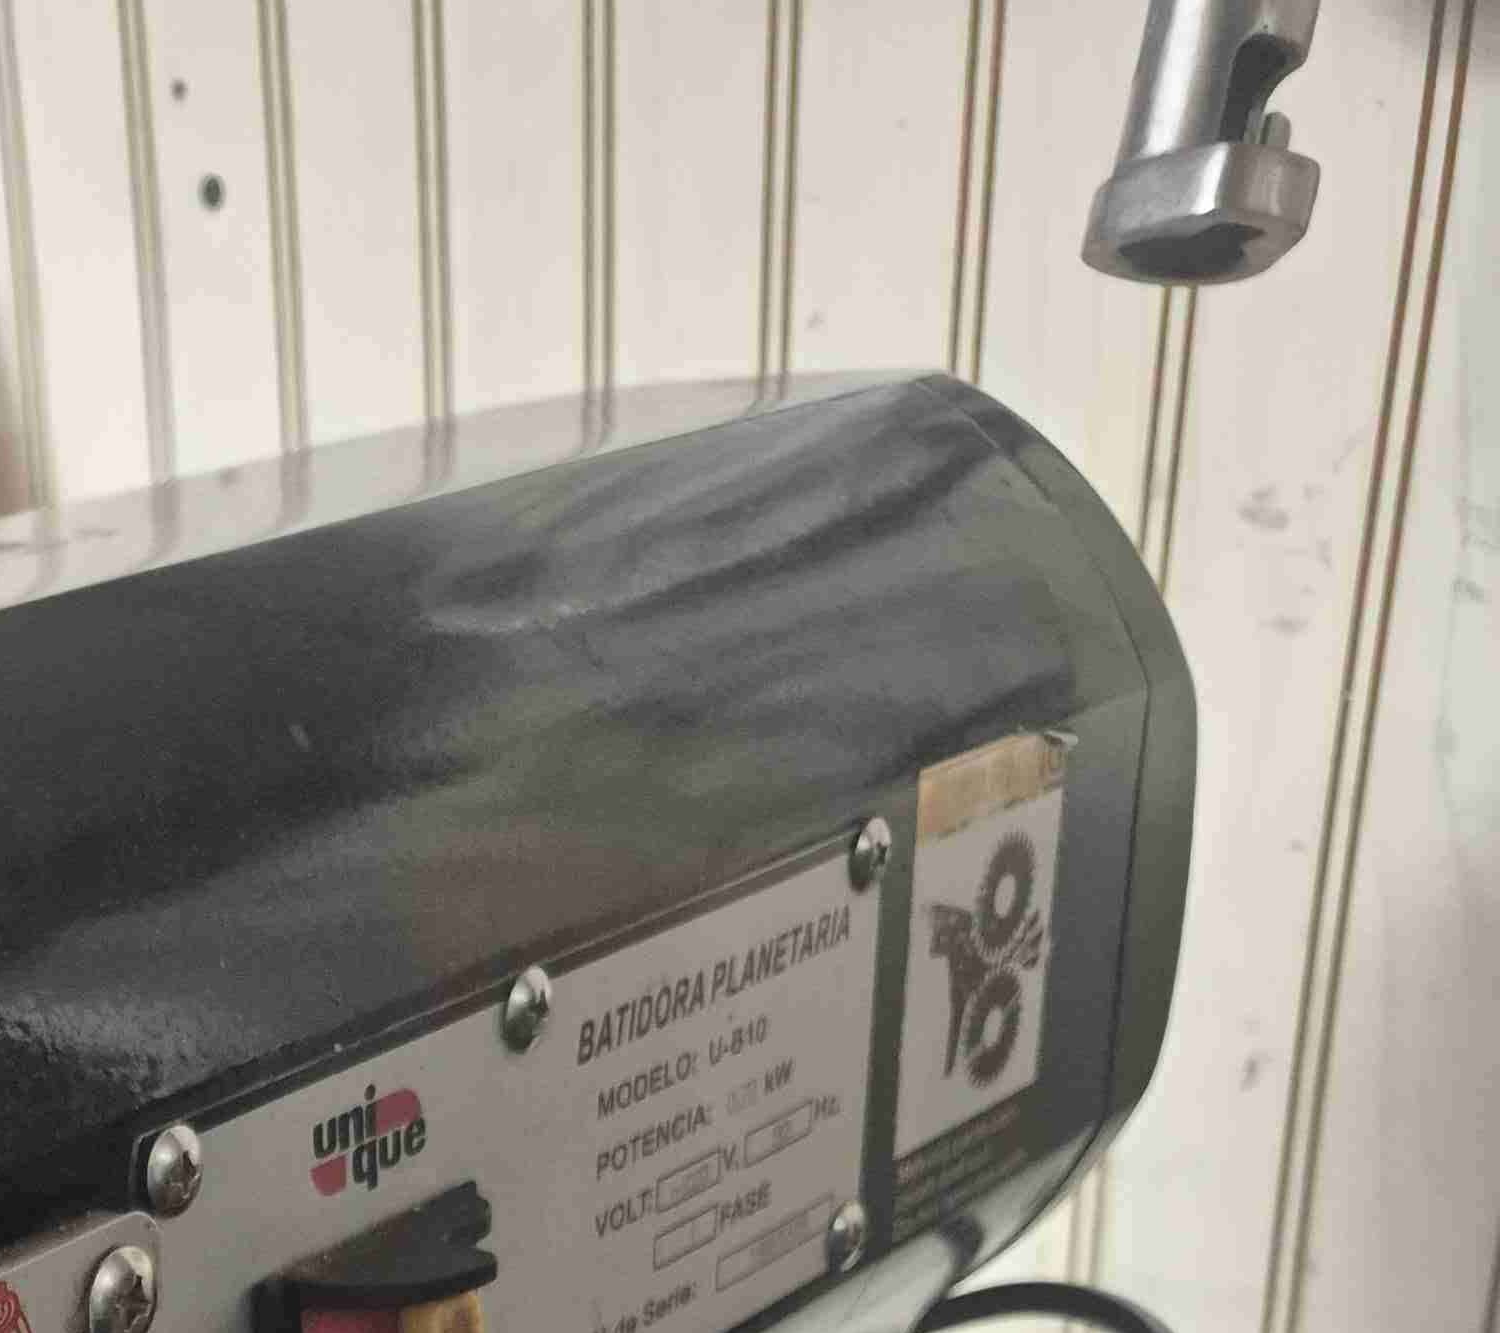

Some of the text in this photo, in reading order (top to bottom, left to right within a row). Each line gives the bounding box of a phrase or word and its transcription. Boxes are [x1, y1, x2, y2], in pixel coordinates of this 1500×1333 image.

[577, 904, 851, 1066] BATIDORA PLANETARIA
[313, 1084, 376, 1159] uni
[597, 1052, 698, 1119] MODELO:
[352, 1117, 426, 1192] que
[596, 1103, 712, 1181] POTENCIA:
